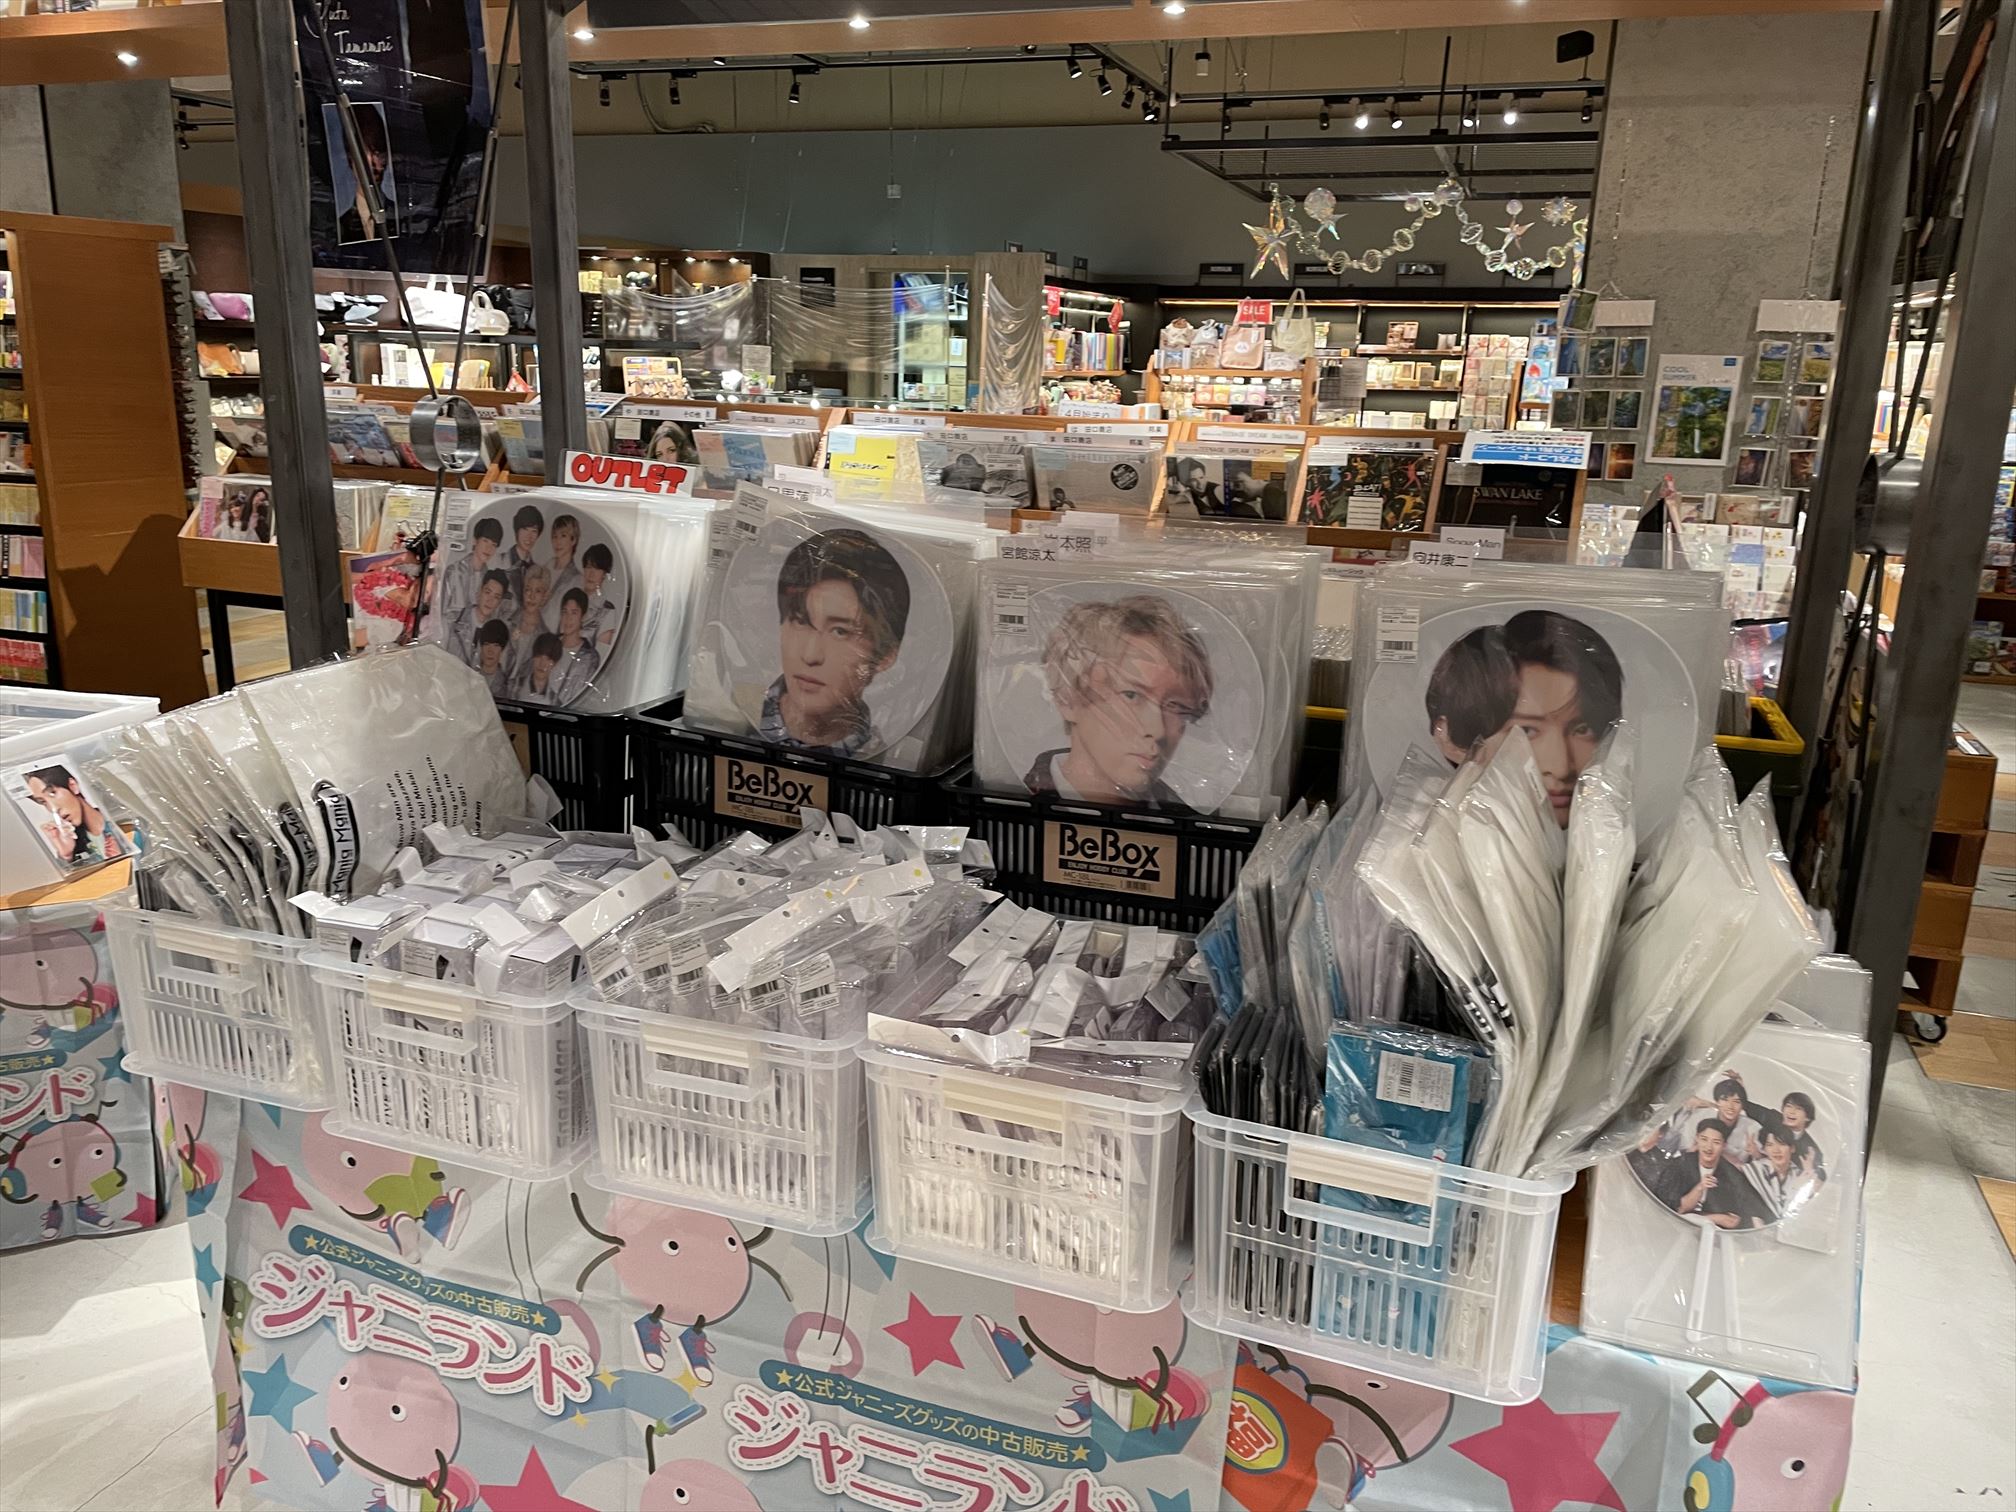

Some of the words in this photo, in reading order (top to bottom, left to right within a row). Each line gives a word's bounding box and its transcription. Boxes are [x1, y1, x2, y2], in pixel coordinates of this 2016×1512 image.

[1242, 305, 1266, 315] SALE
[570, 453, 687, 494] OUTLET
[1510, 488, 1544, 501] LAKE
[1412, 551, 1469, 568] 向井康二
[727, 759, 814, 806] BeBox
[328, 794, 348, 844] Mania
[1059, 823, 1160, 869] BeBox
[256, 1255, 592, 1412] ジャニランド
[795, 1370, 1070, 1464] 公式ジャニーズグッズの中古販売
